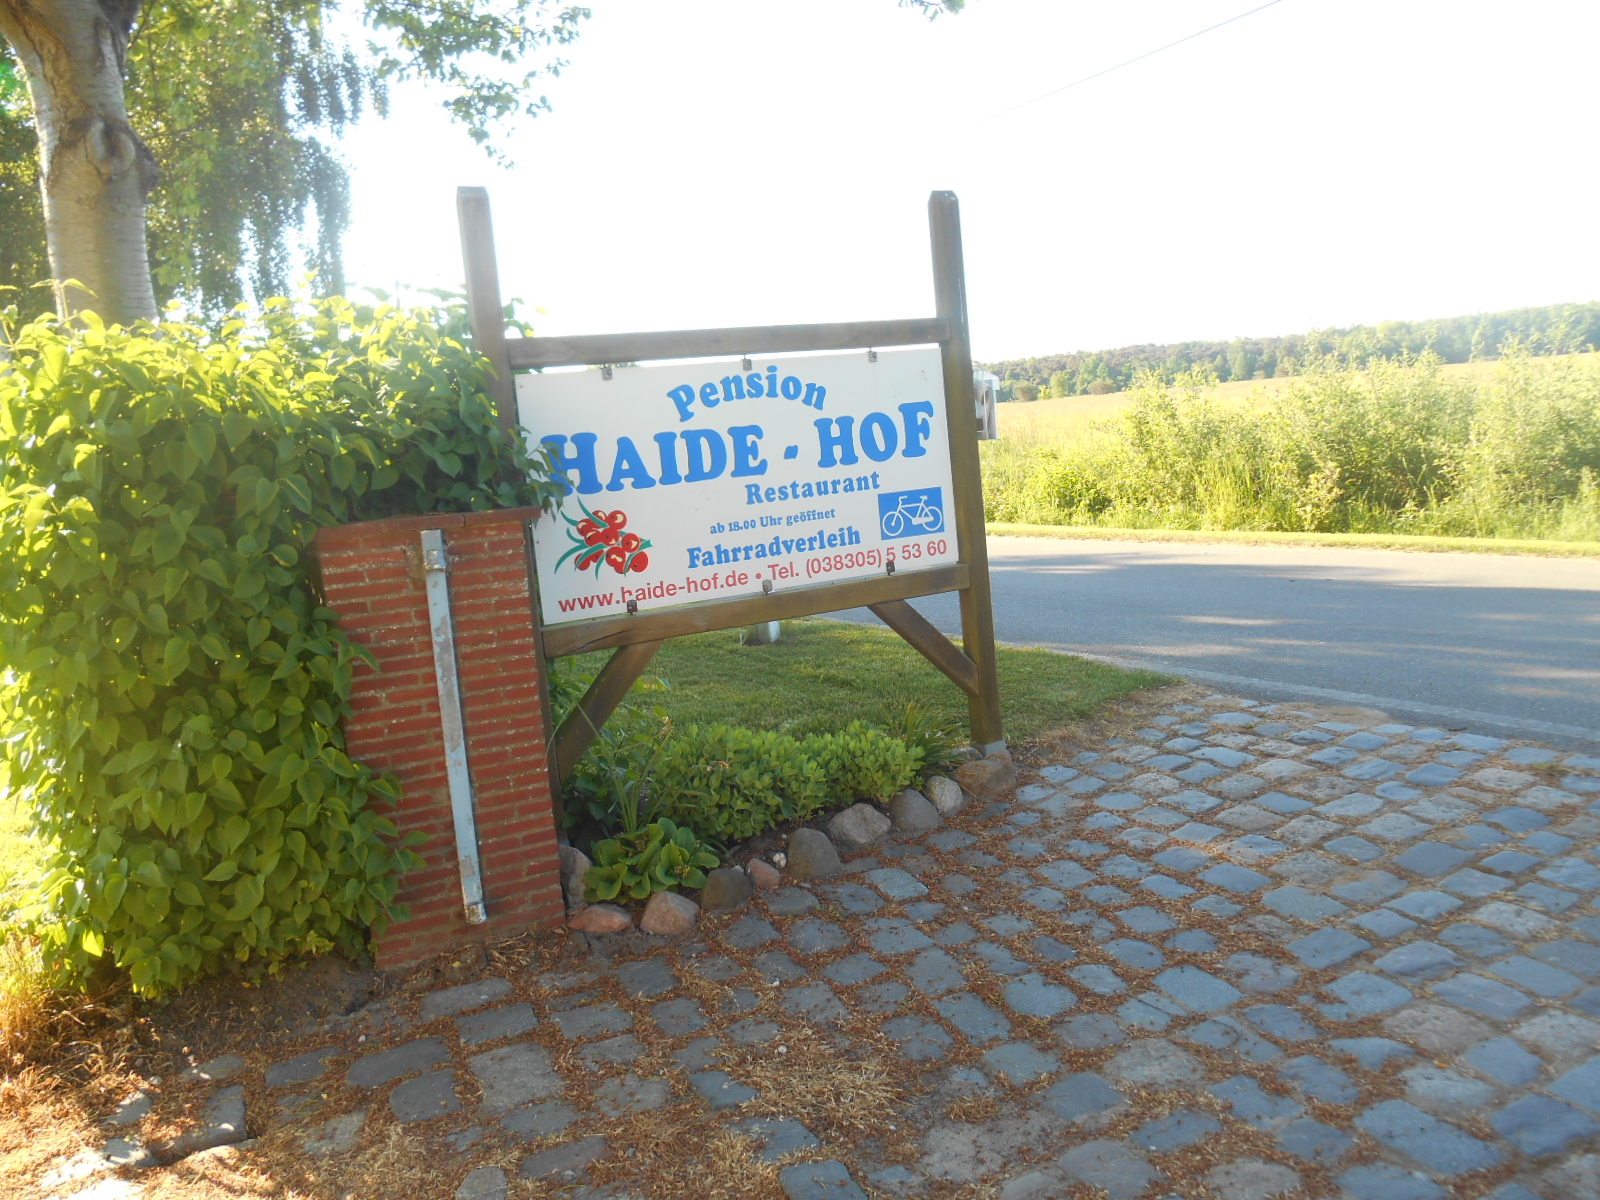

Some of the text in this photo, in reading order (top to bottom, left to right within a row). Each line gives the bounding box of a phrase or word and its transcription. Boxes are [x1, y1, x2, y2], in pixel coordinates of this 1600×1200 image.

[666, 364, 827, 423] Pension
[540, 423, 769, 497] HAIDE
[813, 400, 935, 468] HOF
[744, 471, 881, 505] Restaurant
[686, 525, 862, 569] Fahrradverleih
[709, 508, 836, 535] ab 18.00 Uhr geöffnet
[558, 539, 947, 612] www.haide-hof.de Tel. (038305) 5 53 60
